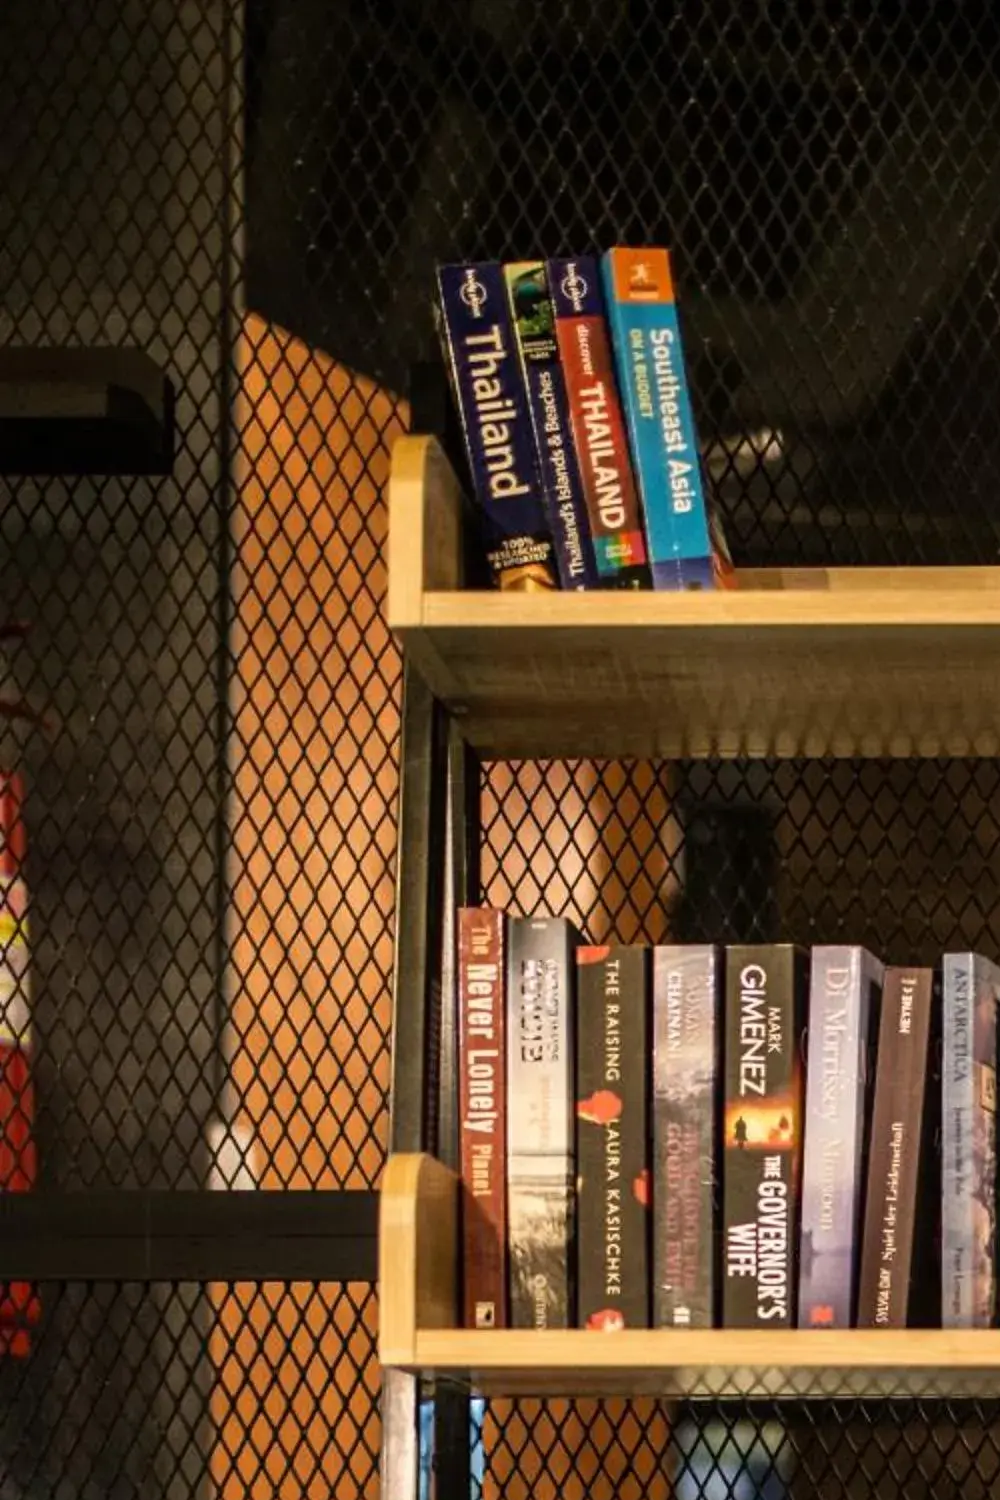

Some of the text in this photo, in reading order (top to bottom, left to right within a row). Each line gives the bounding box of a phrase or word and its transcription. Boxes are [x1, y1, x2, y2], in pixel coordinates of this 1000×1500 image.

[576, 324, 593, 376] discover
[629, 329, 653, 418] ON A BUDGET
[463, 325, 530, 499] Thailand
[539, 371, 557, 433] Beaches
[547, 435, 562, 449] &
[650, 329, 697, 514] Southeast Asia
[550, 449, 574, 502] Islands
[579, 382, 626, 529] THAILAND
[559, 503, 585, 577] Thailand's
[463, 925, 499, 1197] The Never Lonely Planet
[603, 960, 621, 1082] THE RAISING
[739, 964, 767, 1097] GIMENEZ
[767, 1006, 782, 1054] MARK
[817, 967, 849, 1121] Di Morrissey
[953, 968, 968, 1083] ANTARCTICA
[666, 1121, 681, 1192] GOOD
[603, 1119, 622, 1296] LAURA KASISCHKE
[756, 1155, 787, 1320] THE GOVERNOR'S
[882, 1228, 898, 1261] Spiel
[884, 1204, 897, 1227] der
[727, 1223, 757, 1277] WIFE
[874, 1268, 892, 1323] SYLVIA DAY
